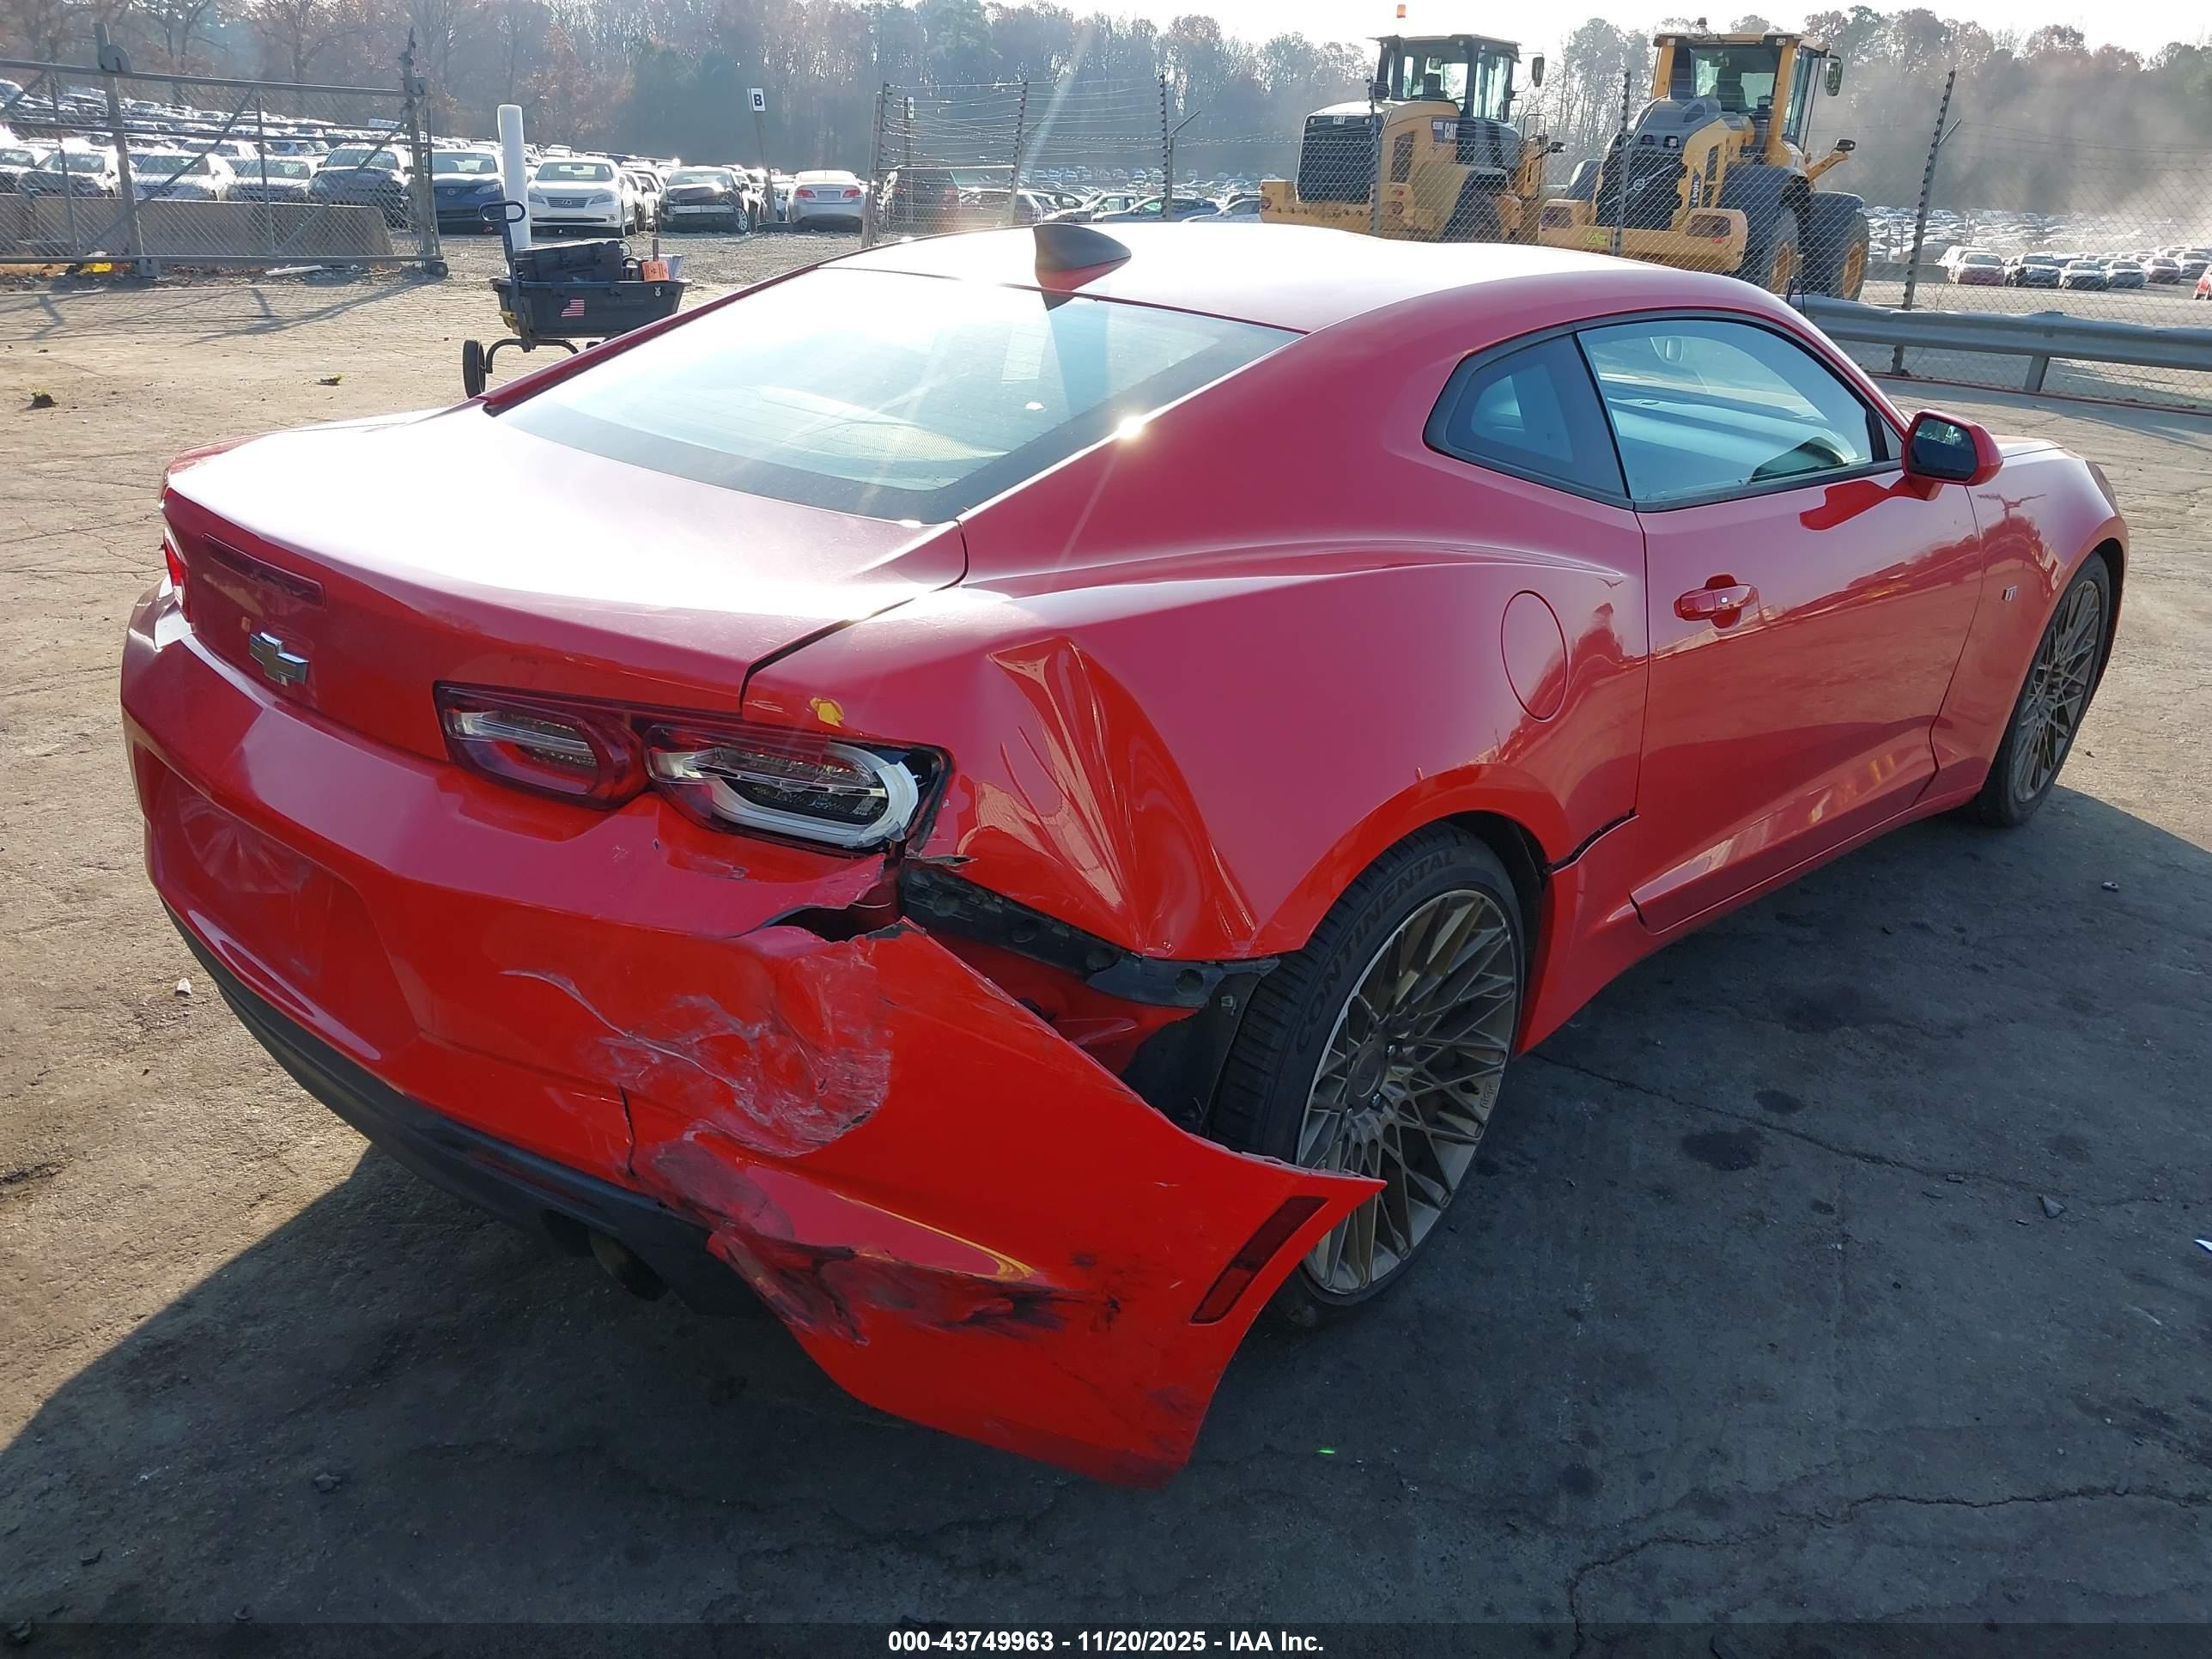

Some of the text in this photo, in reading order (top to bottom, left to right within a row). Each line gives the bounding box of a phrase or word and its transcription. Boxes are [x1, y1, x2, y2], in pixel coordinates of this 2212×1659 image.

[753, 94, 763, 106] B
[1333, 116, 1346, 125] CAT
[1444, 122, 1458, 139] CAT
[1297, 851, 1455, 1054] CONTINENTAL
